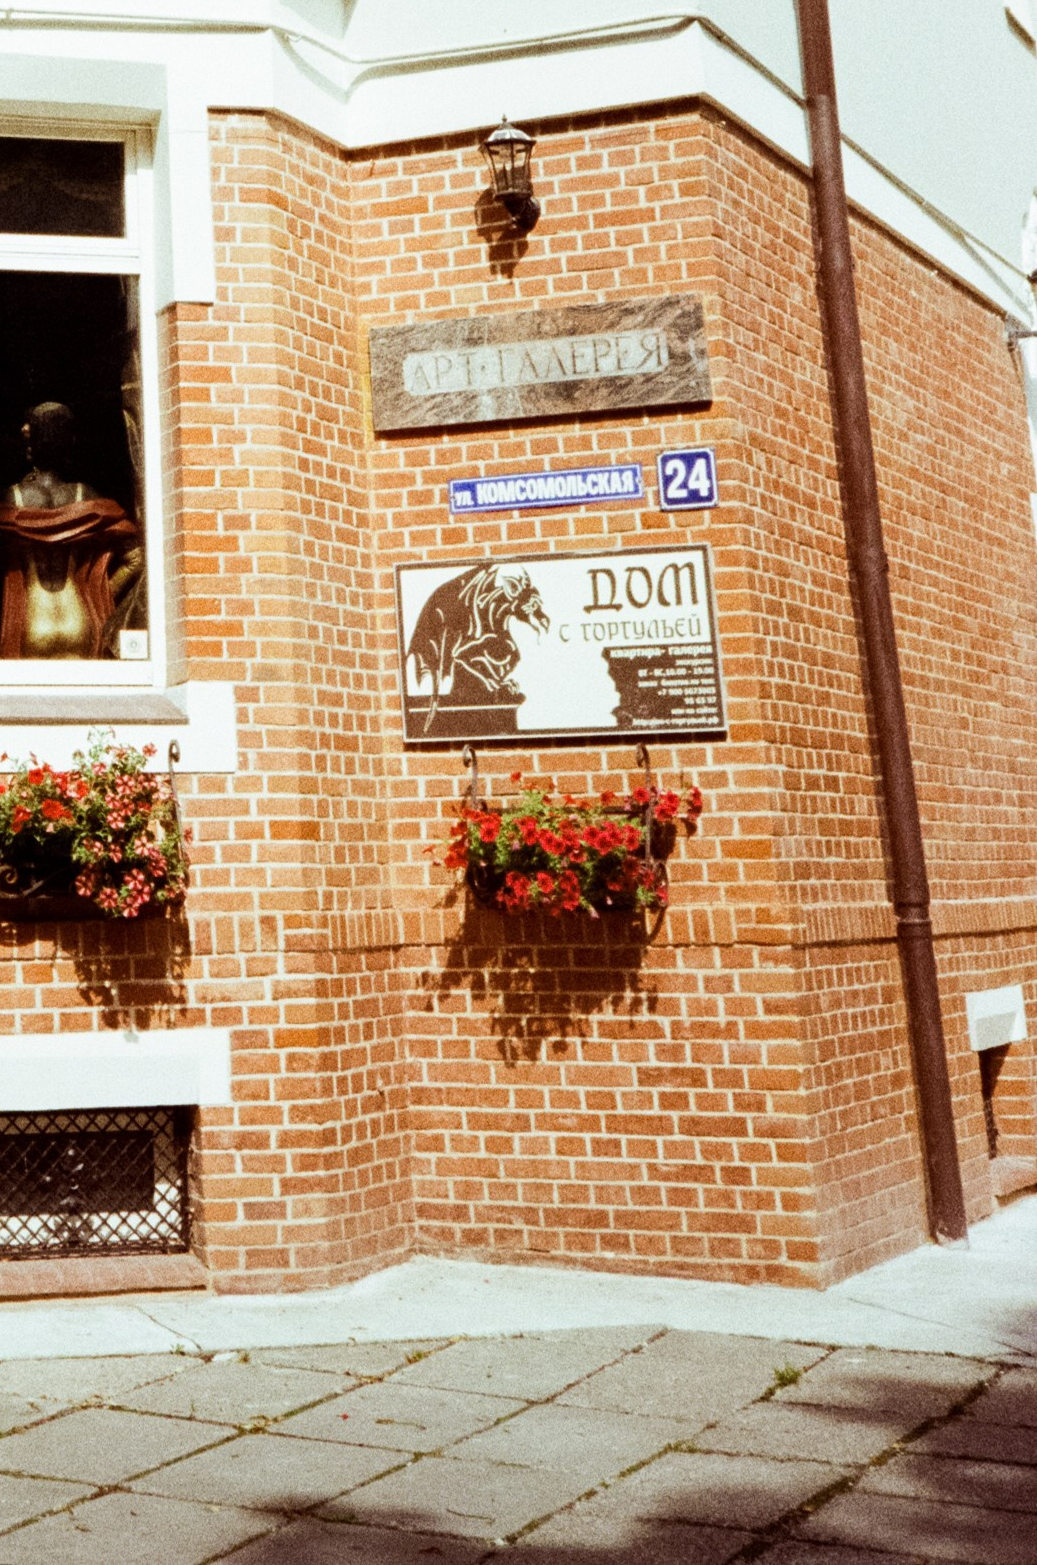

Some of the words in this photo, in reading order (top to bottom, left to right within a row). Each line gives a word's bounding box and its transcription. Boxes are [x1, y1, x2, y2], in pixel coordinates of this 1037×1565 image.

[453, 490, 475, 507] ул.
[476, 470, 636, 506] КОМСОМОЛЬСКАЯ
[664, 457, 711, 499] 24
[582, 561, 699, 614] ДОМ
